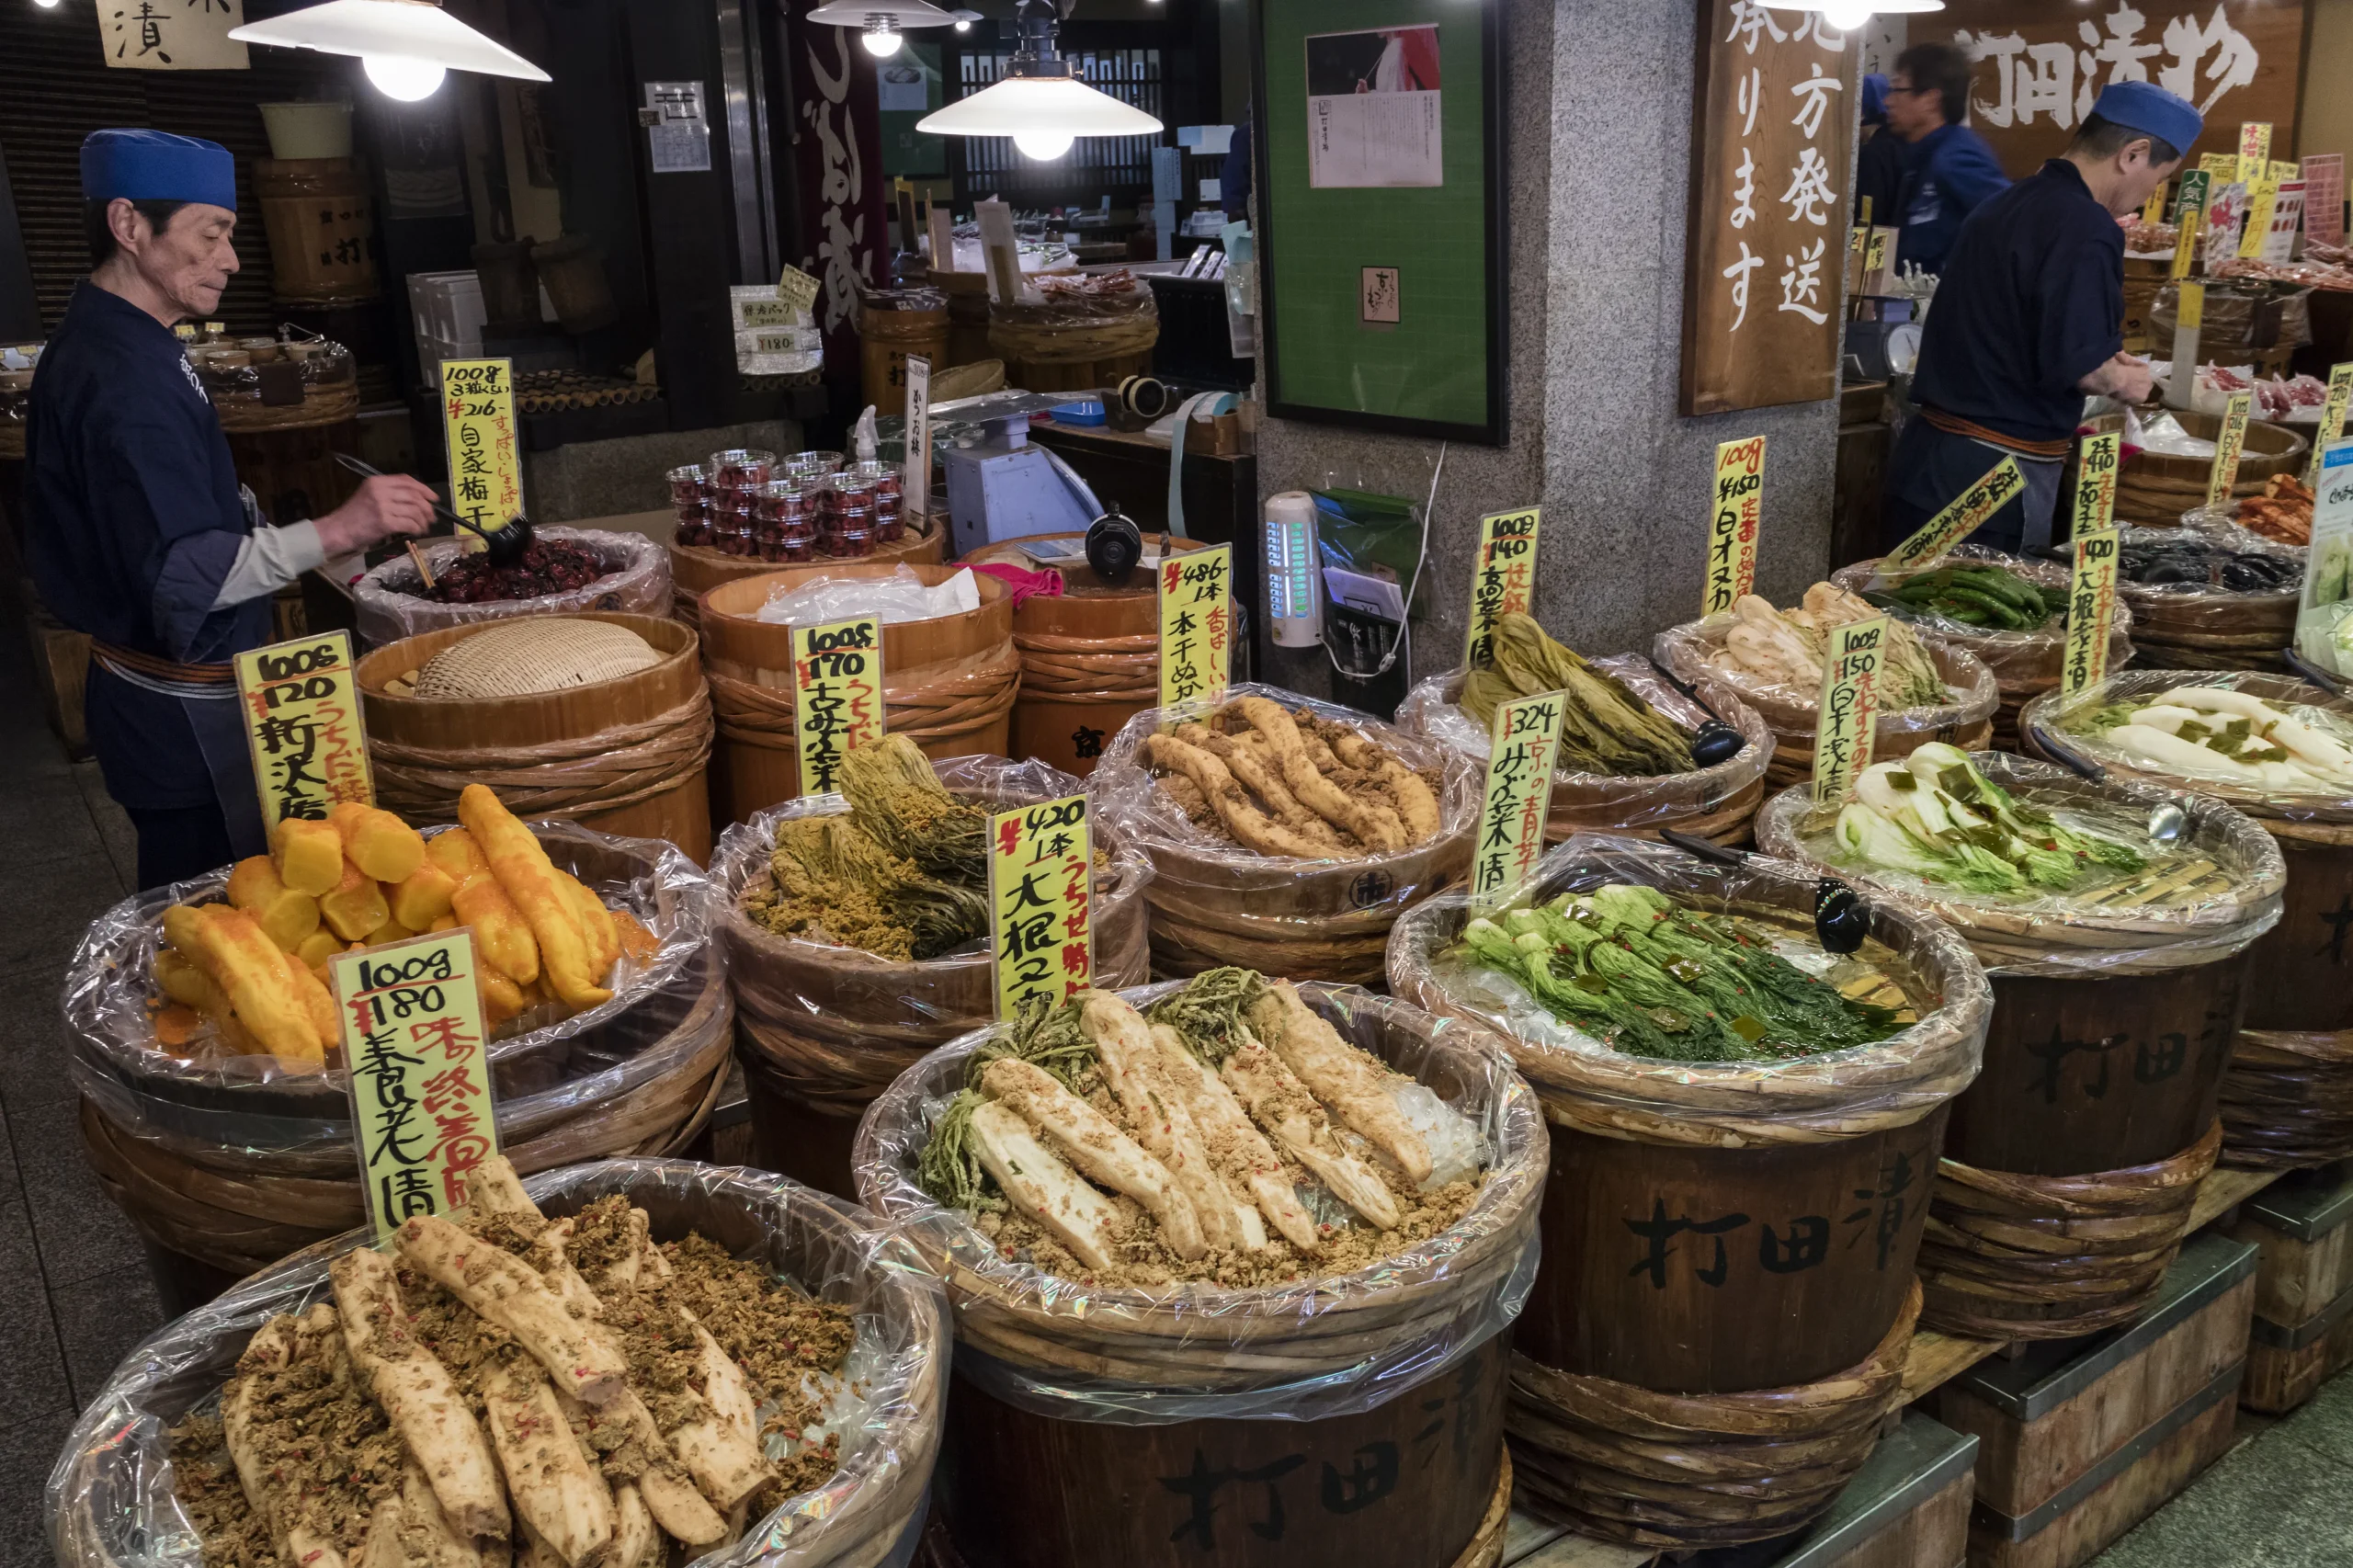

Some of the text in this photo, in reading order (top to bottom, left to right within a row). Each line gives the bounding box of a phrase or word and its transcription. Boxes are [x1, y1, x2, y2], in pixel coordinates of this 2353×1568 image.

[1723, 2, 1788, 332] 承ります
[1716, 473, 1760, 504] ¥150
[1503, 702, 1559, 742] ¥324
[996, 799, 1086, 856] ¥420
[1036, 832, 1074, 862] 1本
[358, 949, 452, 992] 100g
[347, 984, 446, 1037] ¥180
